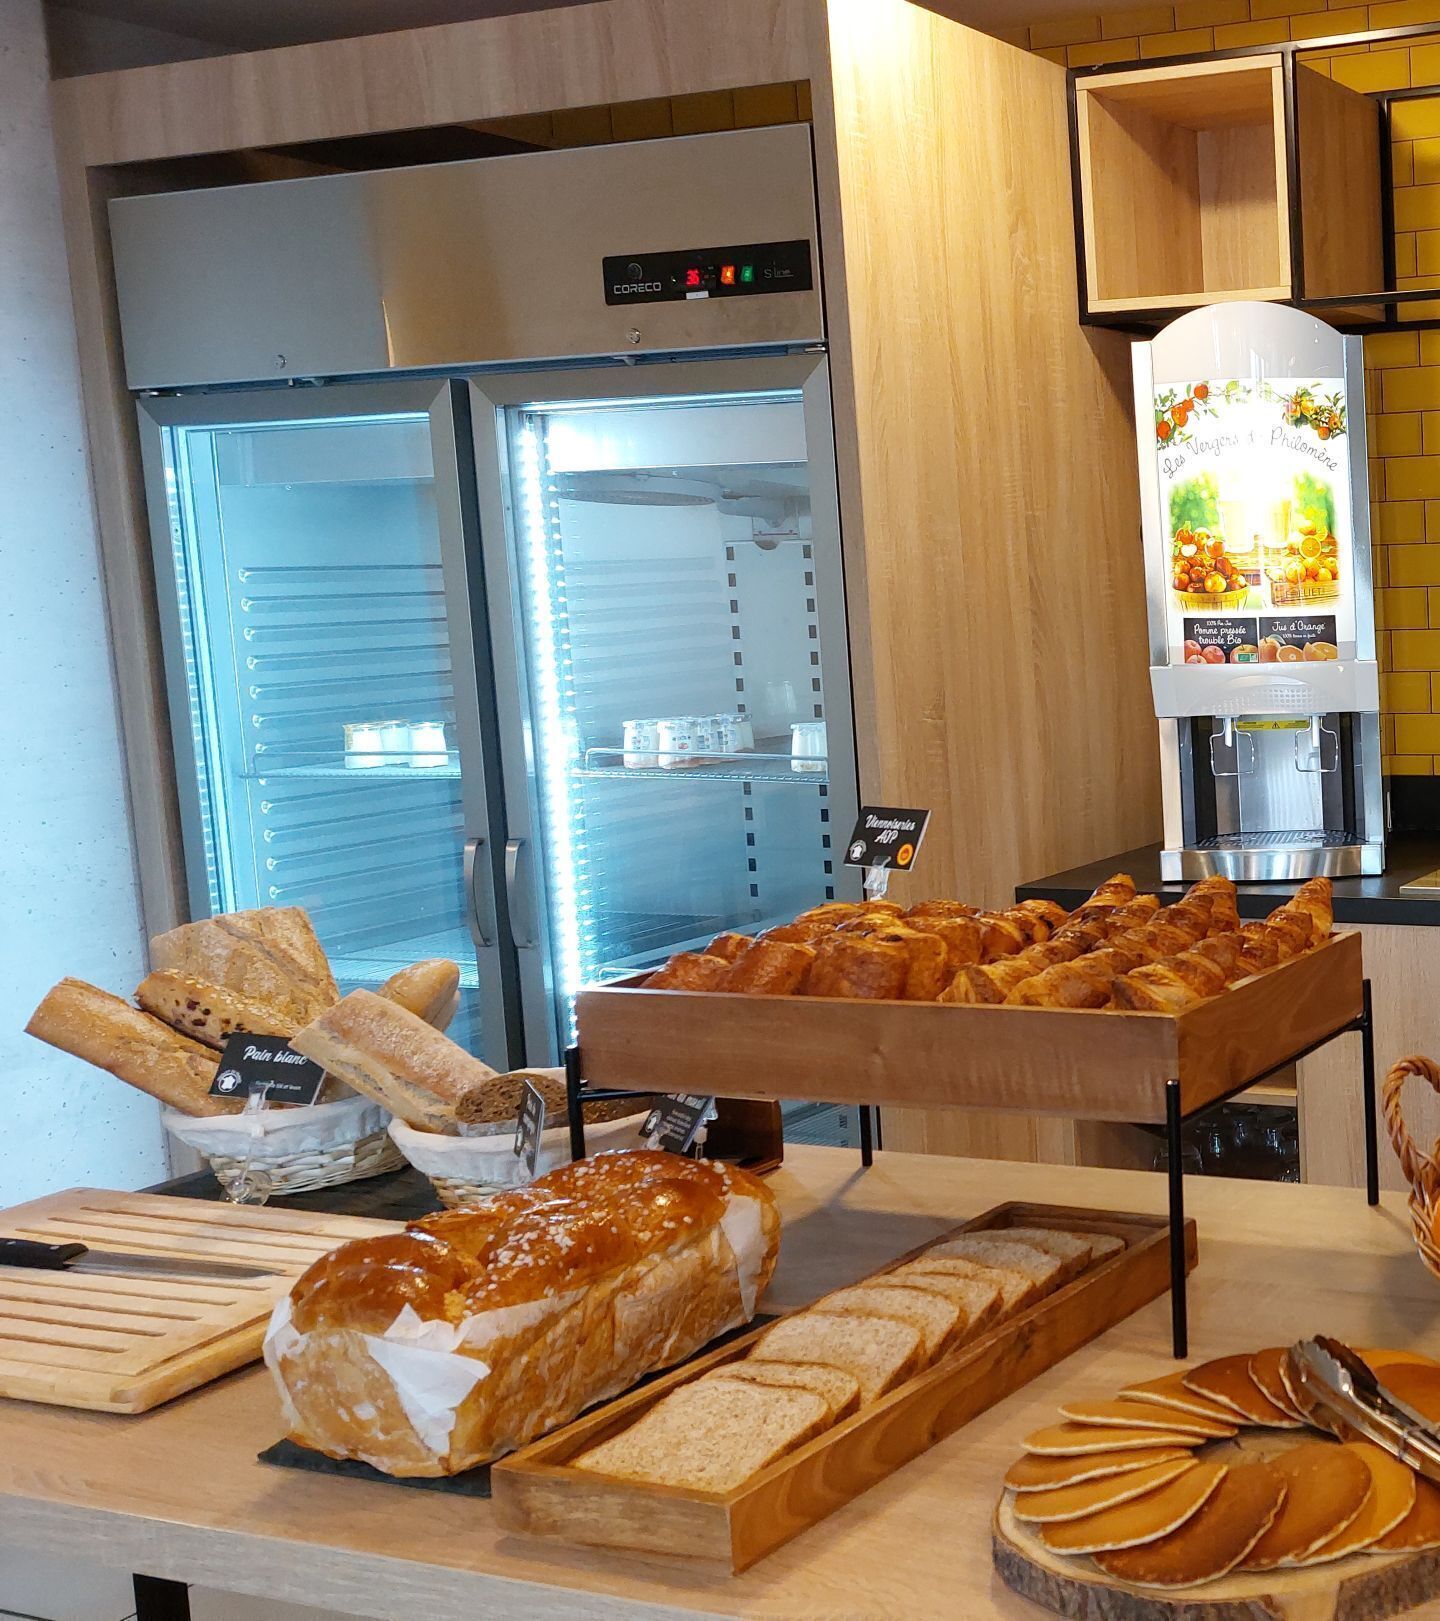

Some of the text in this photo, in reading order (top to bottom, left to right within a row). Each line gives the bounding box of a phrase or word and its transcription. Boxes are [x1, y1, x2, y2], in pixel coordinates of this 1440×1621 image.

[613, 281, 662, 295] CORECO
[1162, 454, 1187, 479] Les
[1186, 434, 1239, 457] Vergers
[1270, 426, 1339, 472] Philomène
[1193, 623, 1247, 636] Pomme pressée
[1271, 620, 1326, 634] Jus d'Orange
[1198, 633, 1242, 645] trouble Bio
[865, 814, 916, 831] Viennoiseries
[874, 829, 899, 845] AOP
[243, 1045, 309, 1065] Pain blanc
